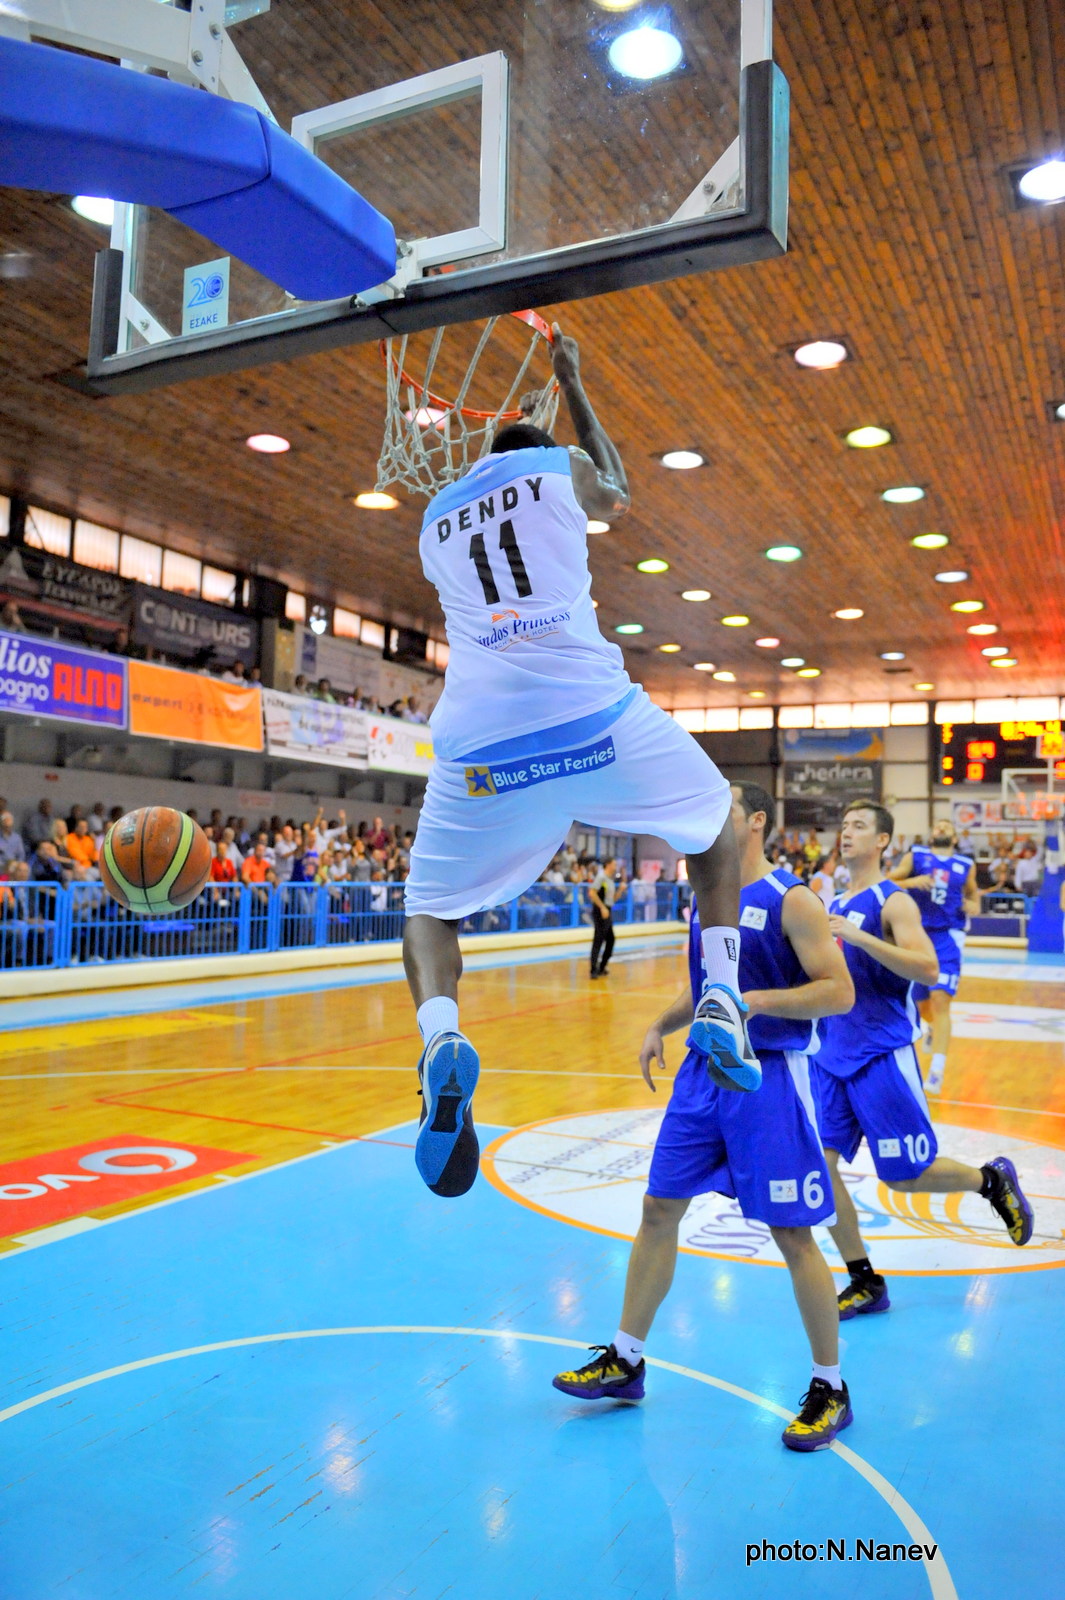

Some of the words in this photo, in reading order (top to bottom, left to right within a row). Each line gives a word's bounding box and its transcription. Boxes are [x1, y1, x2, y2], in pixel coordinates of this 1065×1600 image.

[189, 314, 218, 328] ΕΣΑΚΕ
[437, 477, 543, 544] DENDY
[469, 519, 533, 606] 11
[478, 626, 509, 647] indos
[513, 612, 571, 635] Princess
[532, 625, 558, 637] HOTEL
[492, 770, 528, 787] Blue
[529, 762, 561, 778] Star
[563, 747, 614, 772] Ferries
[904, 1133, 930, 1164] 10
[802, 1170, 825, 1210] 6
